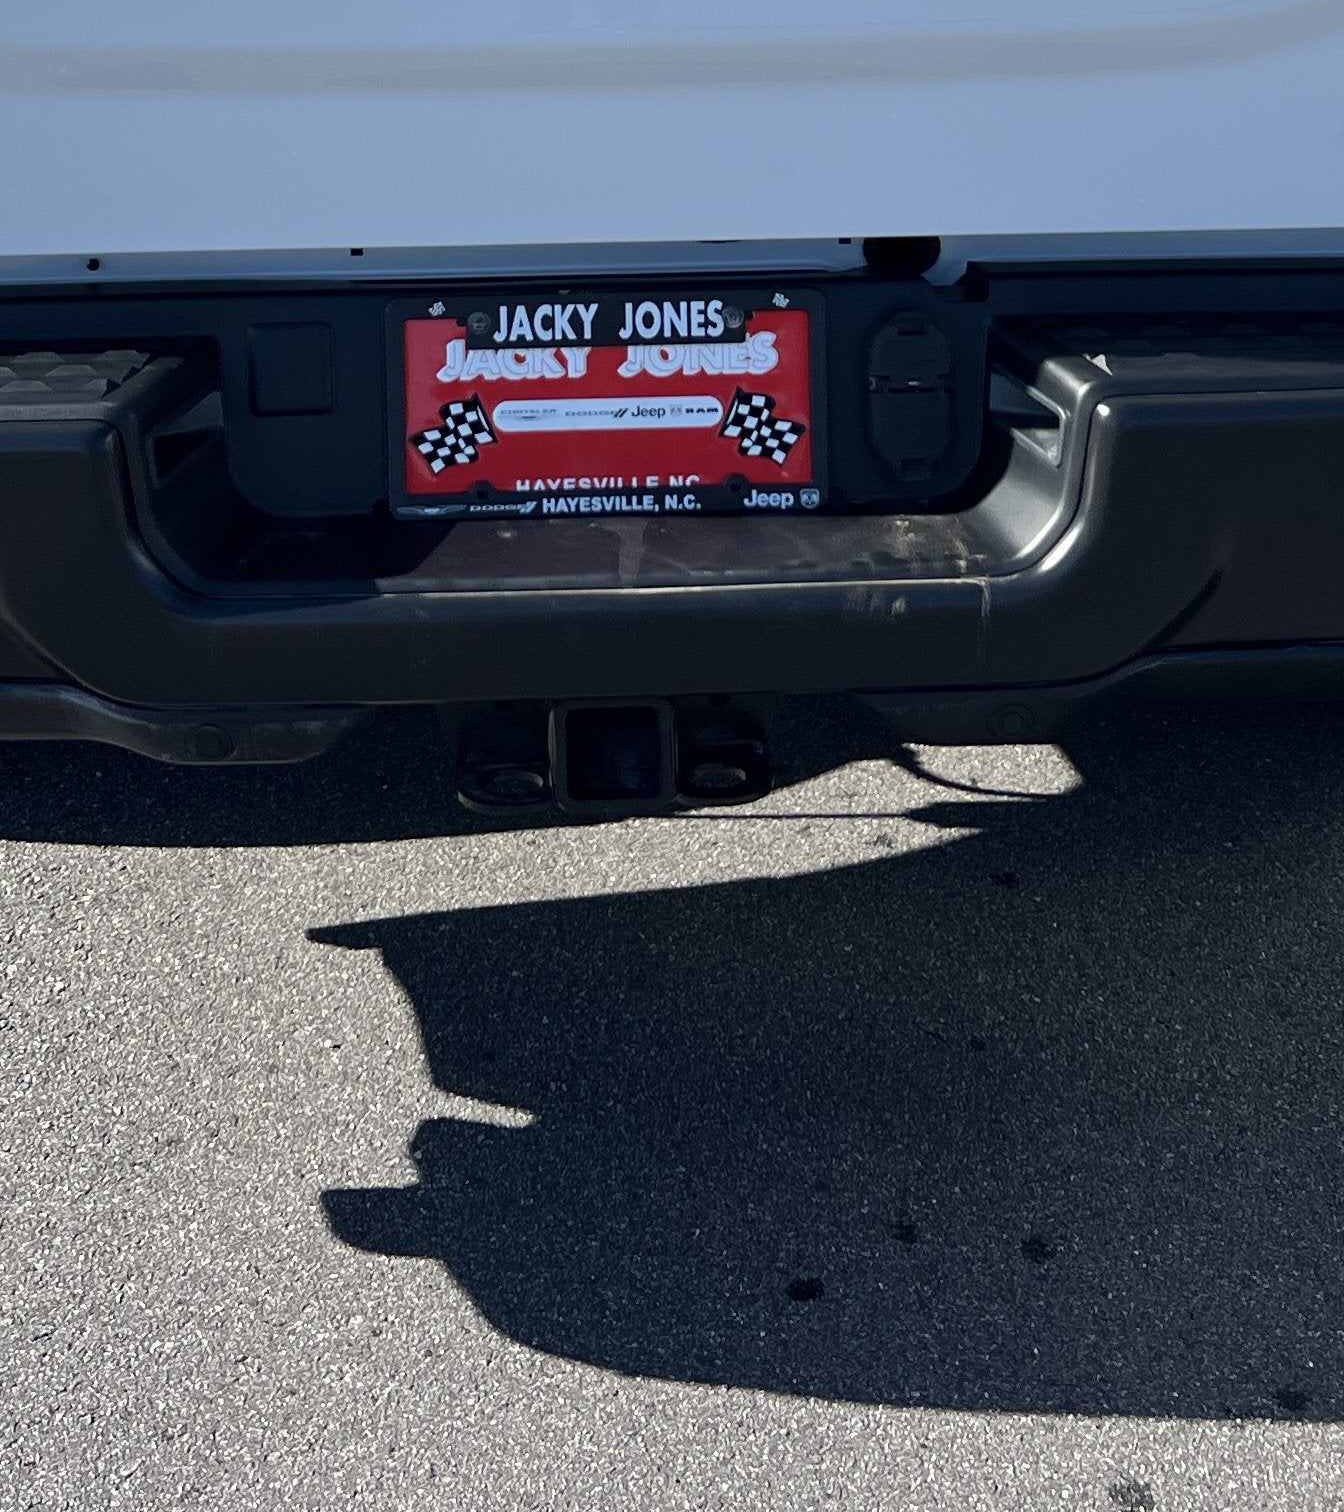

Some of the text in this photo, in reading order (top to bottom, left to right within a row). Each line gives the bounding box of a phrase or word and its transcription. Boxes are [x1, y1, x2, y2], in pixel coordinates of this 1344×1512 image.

[493, 299, 724, 342] JACKY JONES
[435, 331, 779, 383] JACKY JONES
[631, 404, 666, 419] Jeep
[542, 494, 659, 513] HAYESVILLE,
[665, 493, 702, 510] N.C.
[742, 488, 795, 510] Jeep
